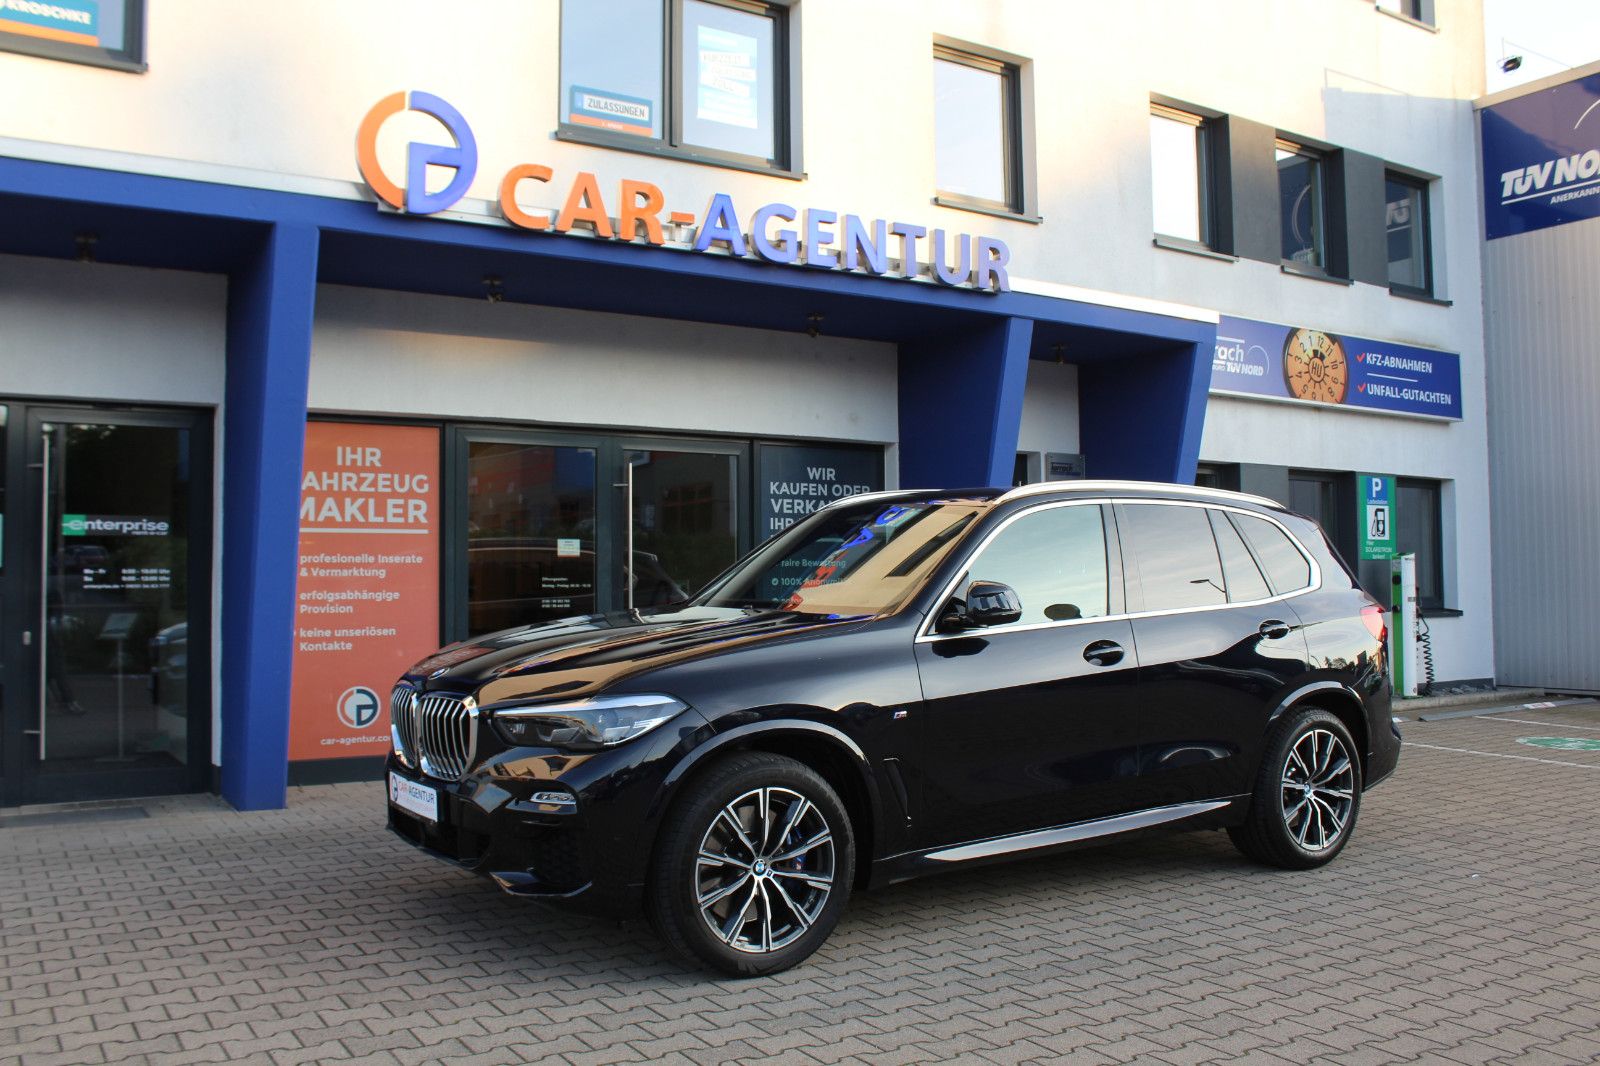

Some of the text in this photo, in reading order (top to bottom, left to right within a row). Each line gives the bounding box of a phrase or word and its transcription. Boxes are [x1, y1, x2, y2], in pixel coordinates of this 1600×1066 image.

[587, 97, 646, 118] ZULASSUNGEN
[1553, 149, 1600, 186] NO
[498, 162, 1011, 293] CAR-AGENTUR
[1240, 363, 1264, 377] NORD
[1366, 352, 1433, 374] KFZ-ABNAHMEN
[1367, 383, 1452, 405] UNFALL-GUTACHTEN
[336, 446, 382, 467] IHR
[807, 466, 836, 481] WIR
[301, 470, 430, 494] AHRZEUG
[770, 481, 828, 497] KAUFEN
[1372, 477, 1382, 498] P
[770, 498, 831, 515] VERKA
[70, 519, 169, 533] enterprise
[378, 553, 424, 564] Inserate
[311, 567, 387, 579] Vermarktung
[300, 589, 401, 602] erfolgsabhängige
[300, 603, 354, 614] Provision
[300, 626, 397, 638] keine unseriösen
[300, 640, 353, 652] Kontakte
